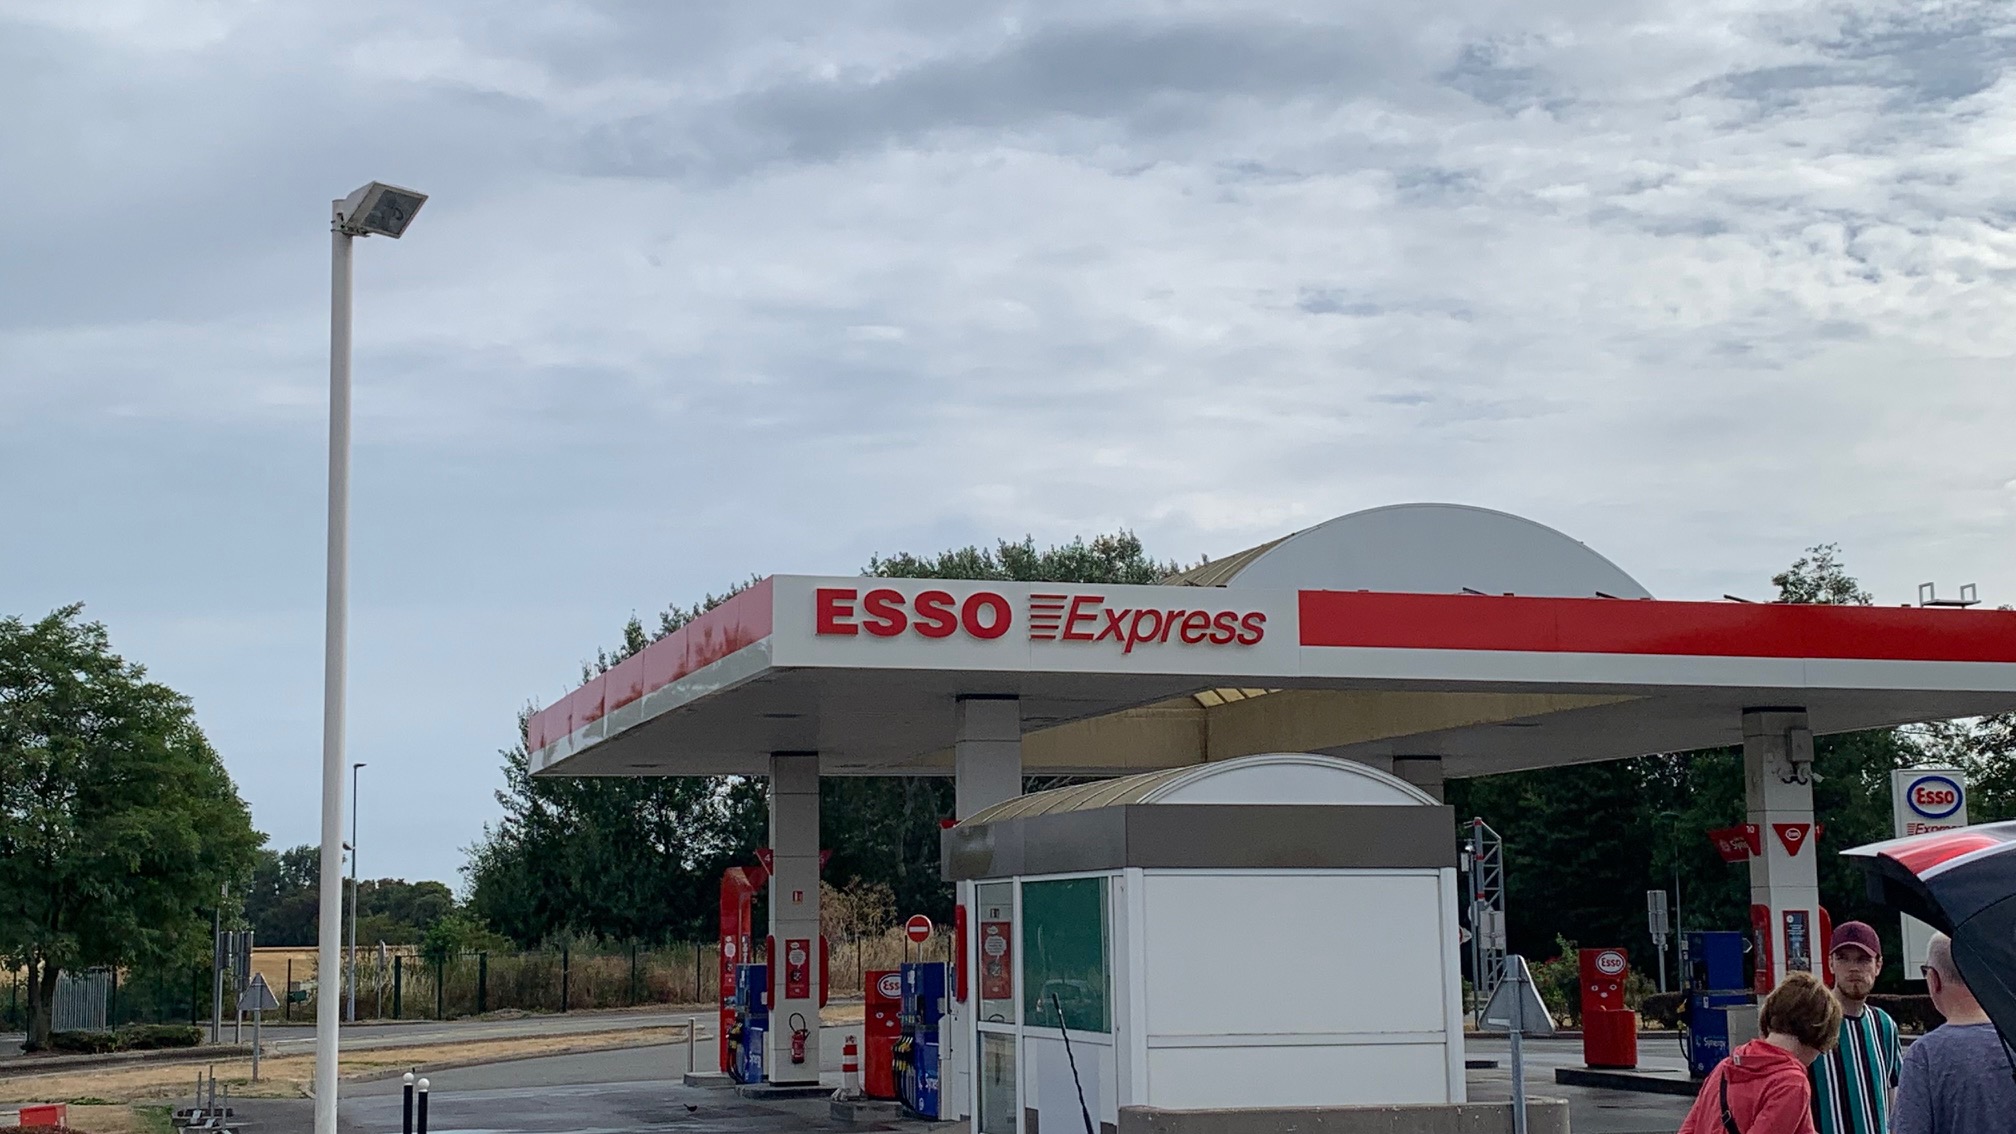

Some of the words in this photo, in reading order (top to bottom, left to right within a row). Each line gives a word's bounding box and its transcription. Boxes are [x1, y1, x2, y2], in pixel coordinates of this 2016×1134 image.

[816, 588, 1013, 640] ESSO
[1062, 595, 1267, 654] Express
[1915, 787, 1955, 805] Esso
[1601, 957, 1621, 967] Esso
